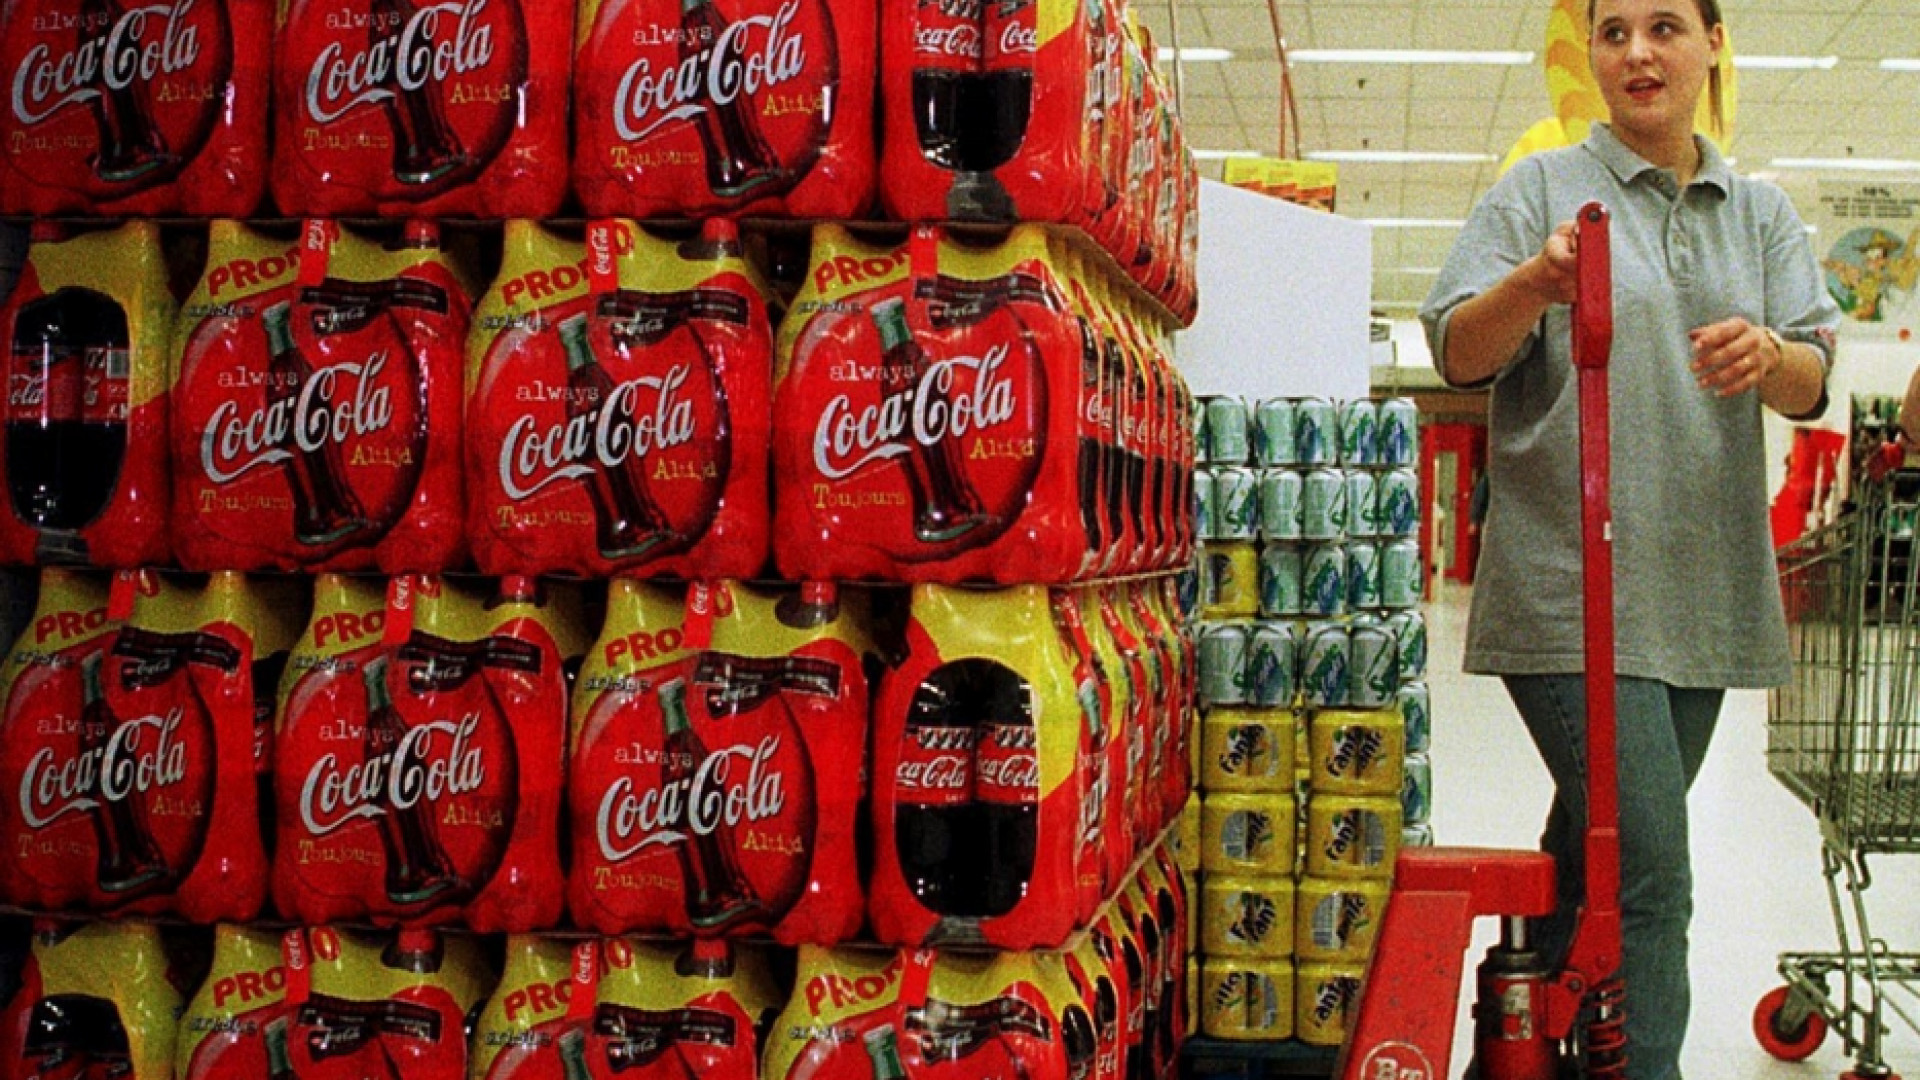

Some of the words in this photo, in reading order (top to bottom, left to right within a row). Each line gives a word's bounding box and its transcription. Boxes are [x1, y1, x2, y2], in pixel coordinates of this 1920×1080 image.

[32, 10, 109, 32] always
[325, 10, 401, 31] always
[632, 23, 712, 44] always
[12, 0, 199, 125] Coca-Cola
[306, 0, 493, 125] Coca-Cola
[612, 1, 804, 141] Coca-Cola
[217, 367, 298, 391] always
[829, 361, 917, 383] always
[516, 381, 599, 405] always
[200, 349, 393, 484] Coca-Cola
[813, 342, 1017, 480] Coca-Cola
[499, 363, 695, 500] Coca-Cola
[814, 484, 906, 509] Toujours
[37, 714, 105, 740] always
[318, 720, 393, 745] always
[19, 705, 185, 829] Coca-Cola
[614, 743, 693, 769] always
[300, 711, 484, 836] Coca-Cola
[596, 733, 785, 862] Coca-Cola
